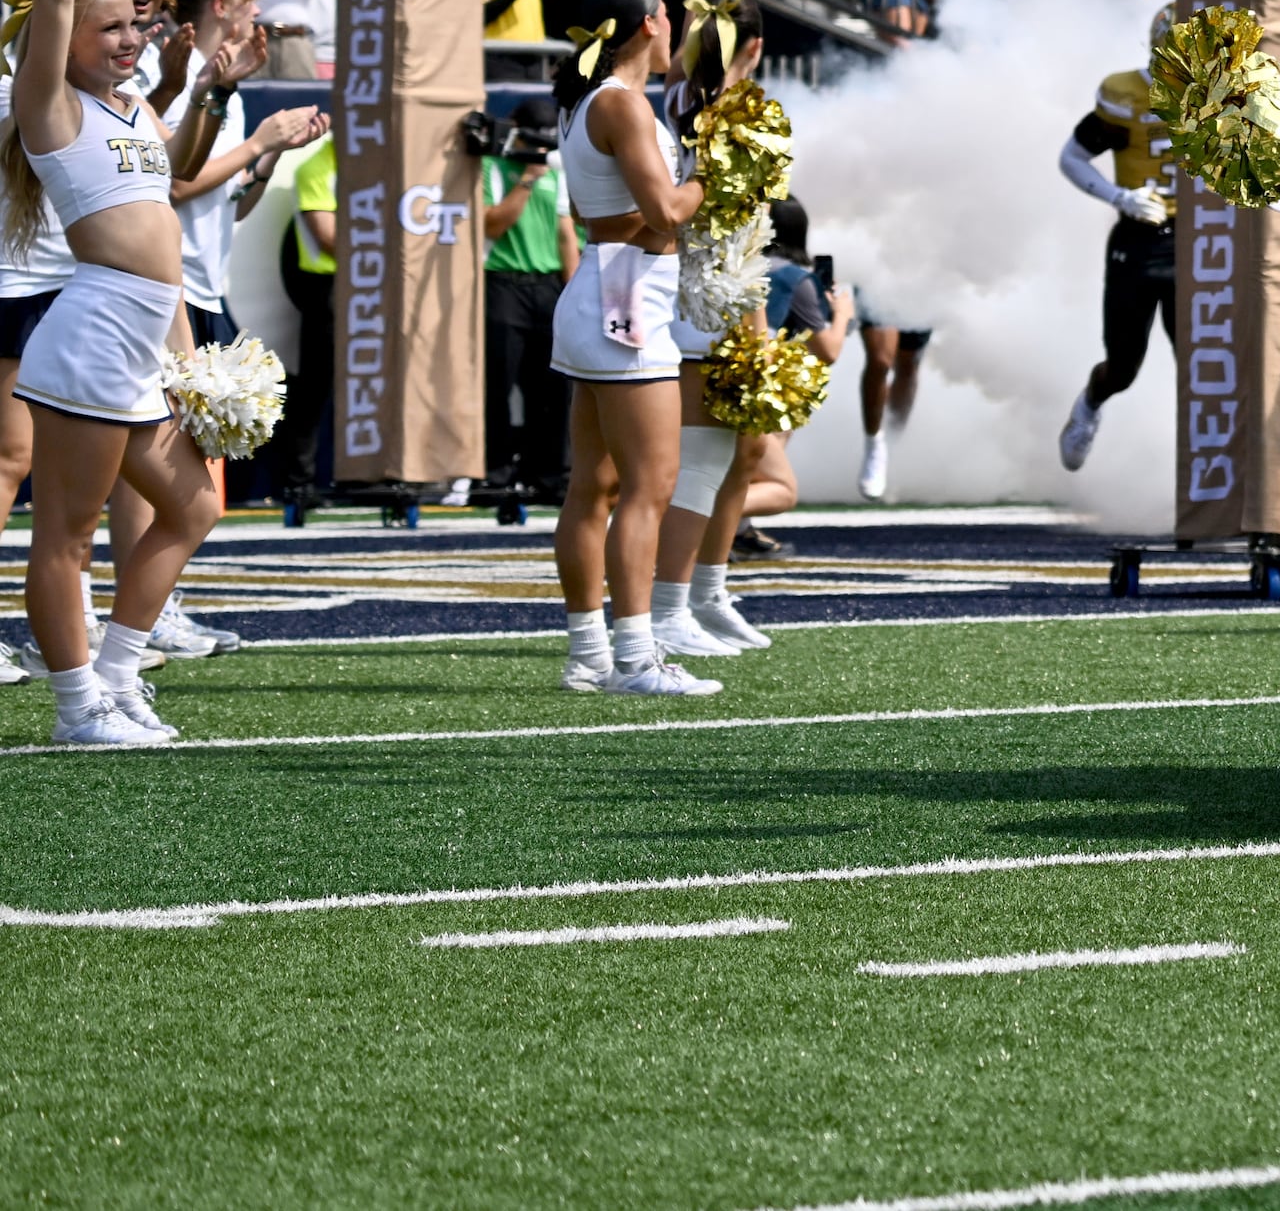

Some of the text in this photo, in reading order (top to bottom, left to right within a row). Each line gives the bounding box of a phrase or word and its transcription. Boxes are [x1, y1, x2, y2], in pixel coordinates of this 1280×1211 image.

[106, 138, 172, 178] TEC
[398, 184, 468, 245] GT
[346, 182, 386, 458] GEORGIA
[1189, 175, 1239, 503] GEORGI
